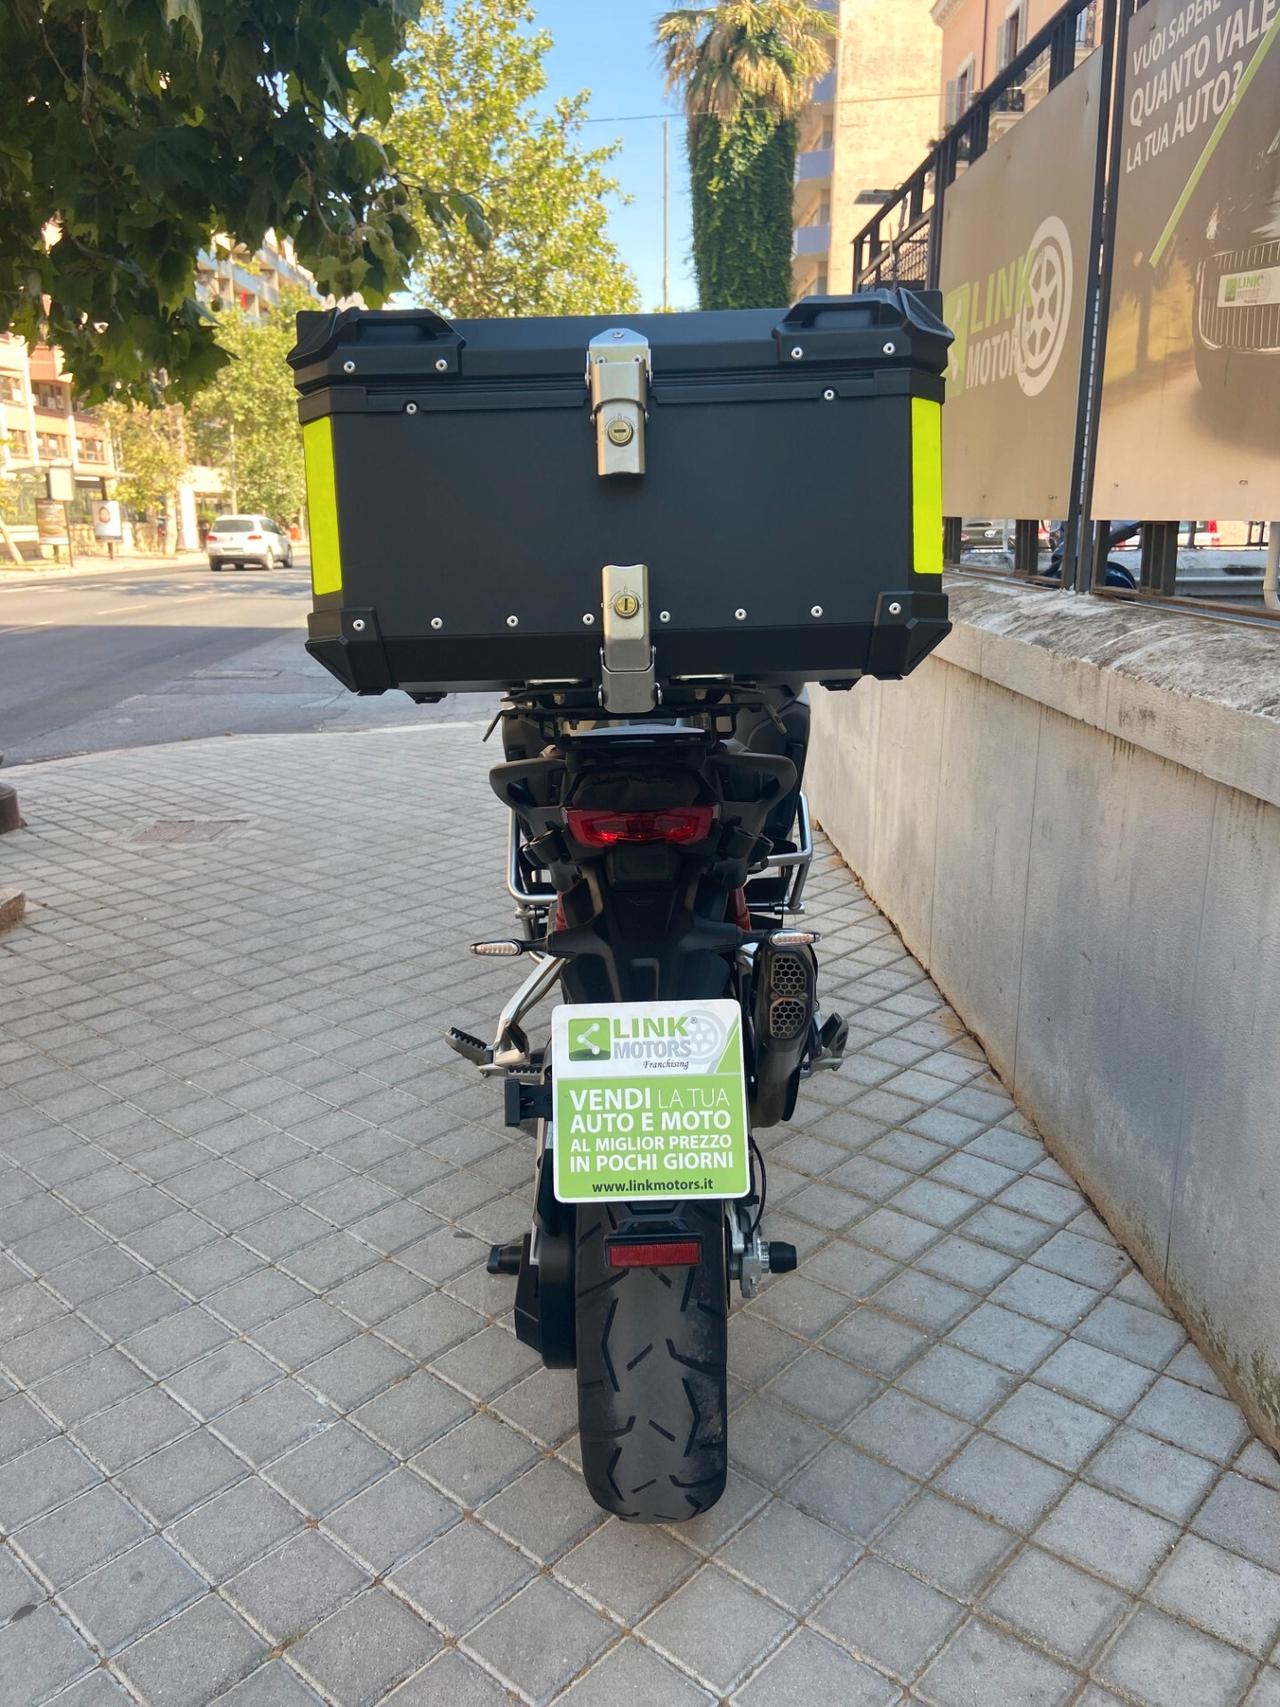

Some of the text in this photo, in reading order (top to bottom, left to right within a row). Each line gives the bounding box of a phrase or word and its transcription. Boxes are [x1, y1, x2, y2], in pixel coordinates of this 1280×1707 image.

[1133, 27, 1166, 75] VUOI
[1129, 0, 1276, 127] QUANTO VALE
[1125, 141, 1141, 174] LA
[1144, 122, 1169, 161] TUA
[970, 247, 1037, 335] LINK
[614, 1040, 692, 1059] MOTORS
[643, 1060, 689, 1069] Franchising
[570, 1087, 730, 1111] VENDI LA TUA
[570, 1110, 731, 1134] AUTO E MOTO
[570, 1134, 732, 1153] AL MIGLIOR PREZZO
[570, 1151, 734, 1173] IN POCHI GIORNI
[592, 1177, 714, 1193] www.linkmotors.it
